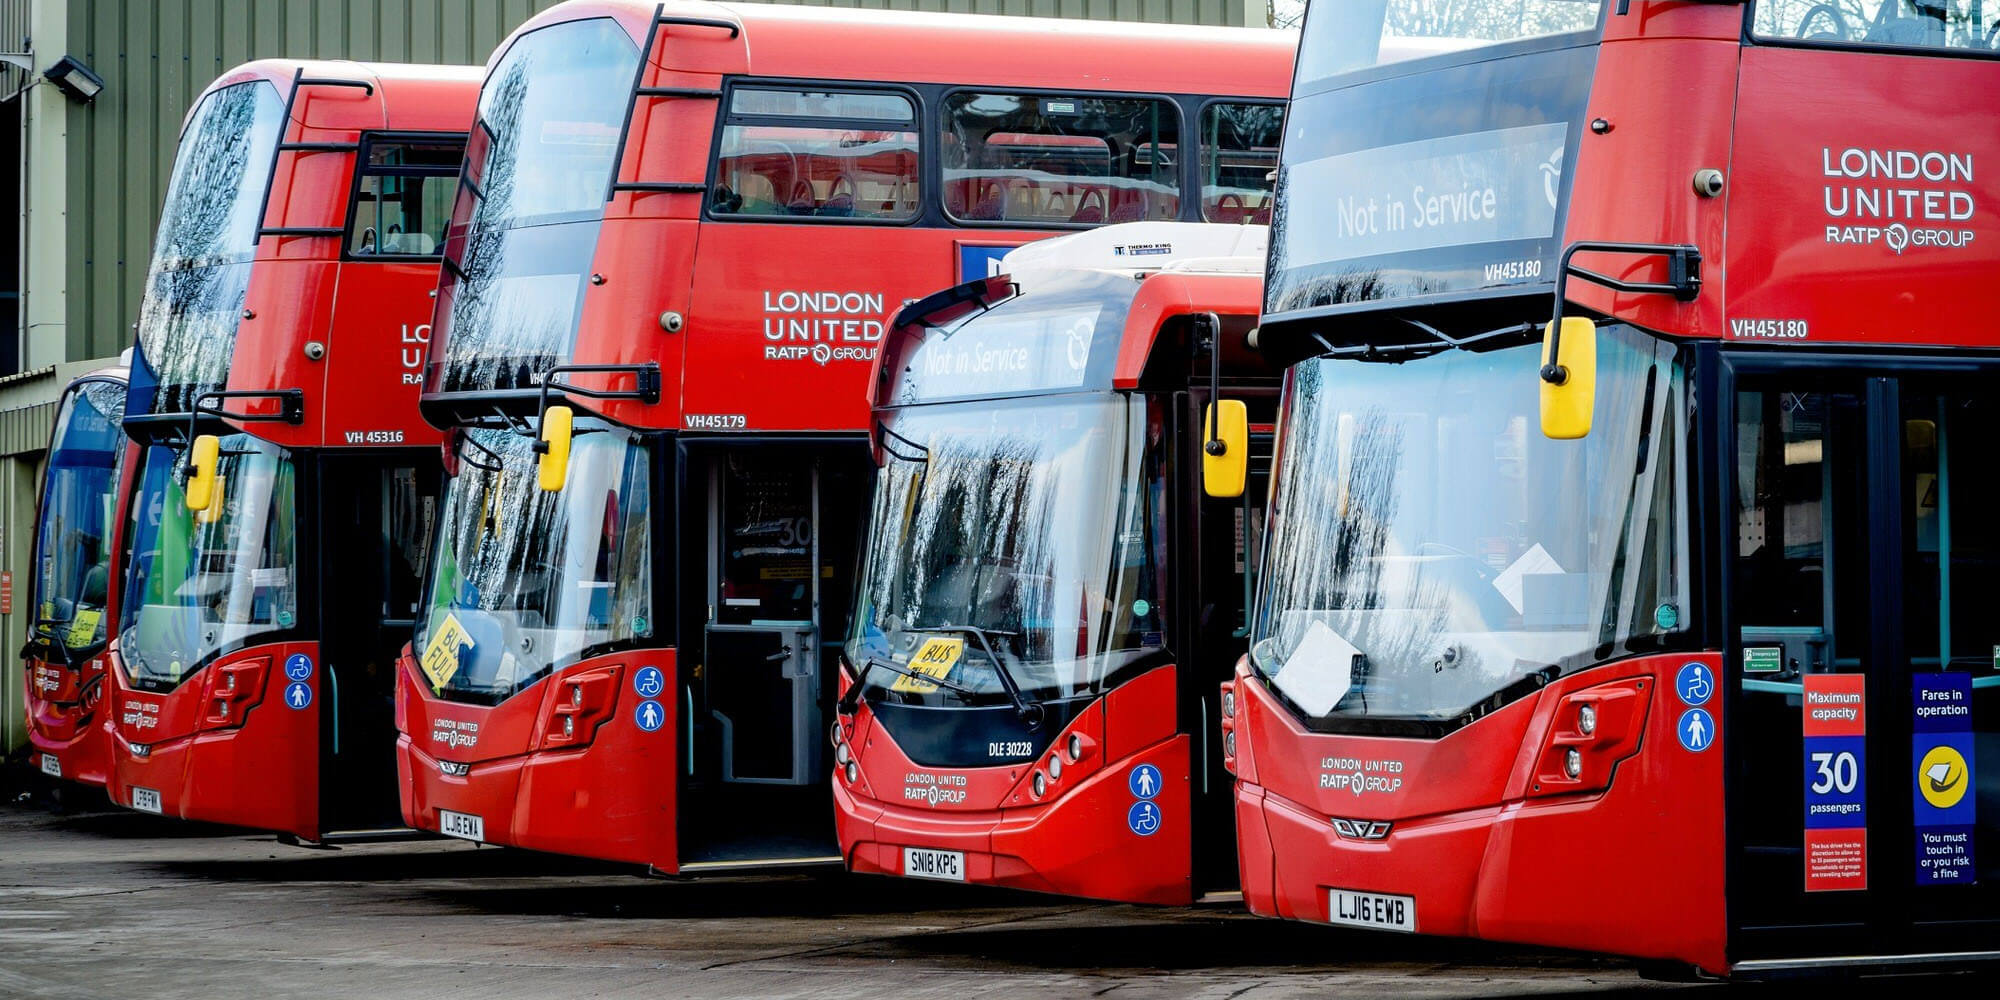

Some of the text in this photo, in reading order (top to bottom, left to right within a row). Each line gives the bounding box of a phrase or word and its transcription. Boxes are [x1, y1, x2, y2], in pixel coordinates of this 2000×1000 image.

[1822, 147, 1974, 183] LONDON
[1338, 183, 1496, 238] Not in Service
[1824, 186, 1975, 221] UNITED
[1825, 226, 1975, 248] RATP GROUP
[1484, 259, 1542, 281] VH45180
[764, 291, 883, 314] LONDON
[765, 319, 883, 341] UNITED
[1731, 319, 1808, 338] VH45180
[765, 346, 809, 359] RATP
[924, 340, 1028, 376] Not in Service
[685, 415, 746, 428] VH45179
[345, 431, 404, 443] VH 45316
[921, 644, 955, 664] BUS
[1808, 691, 1861, 703] Maximum
[1922, 689, 1962, 701] Fares in
[1812, 707, 1857, 720] capacity
[1917, 704, 1968, 718] operation
[434, 718, 478, 732] LONDON UNITED
[433, 730, 477, 747] RATP GROUP
[988, 741, 1032, 757] DLE 30228
[1322, 756, 1403, 774] LONDON UNITED
[1811, 751, 1858, 794] 30
[905, 773, 967, 786] LONDON UNITED
[1320, 773, 1402, 793] RATP GROUP
[904, 787, 966, 803] RATP GROUP
[1810, 803, 1861, 815] passengers
[445, 813, 479, 837] LJ16 EWA
[1922, 832, 1968, 843] You must
[1926, 844, 1964, 855] touch in
[911, 851, 957, 875] SN18 KPG
[1920, 856, 1970, 869] or you risk
[1932, 868, 1959, 879] a fine
[1339, 894, 1405, 926] LJ16 EWB
